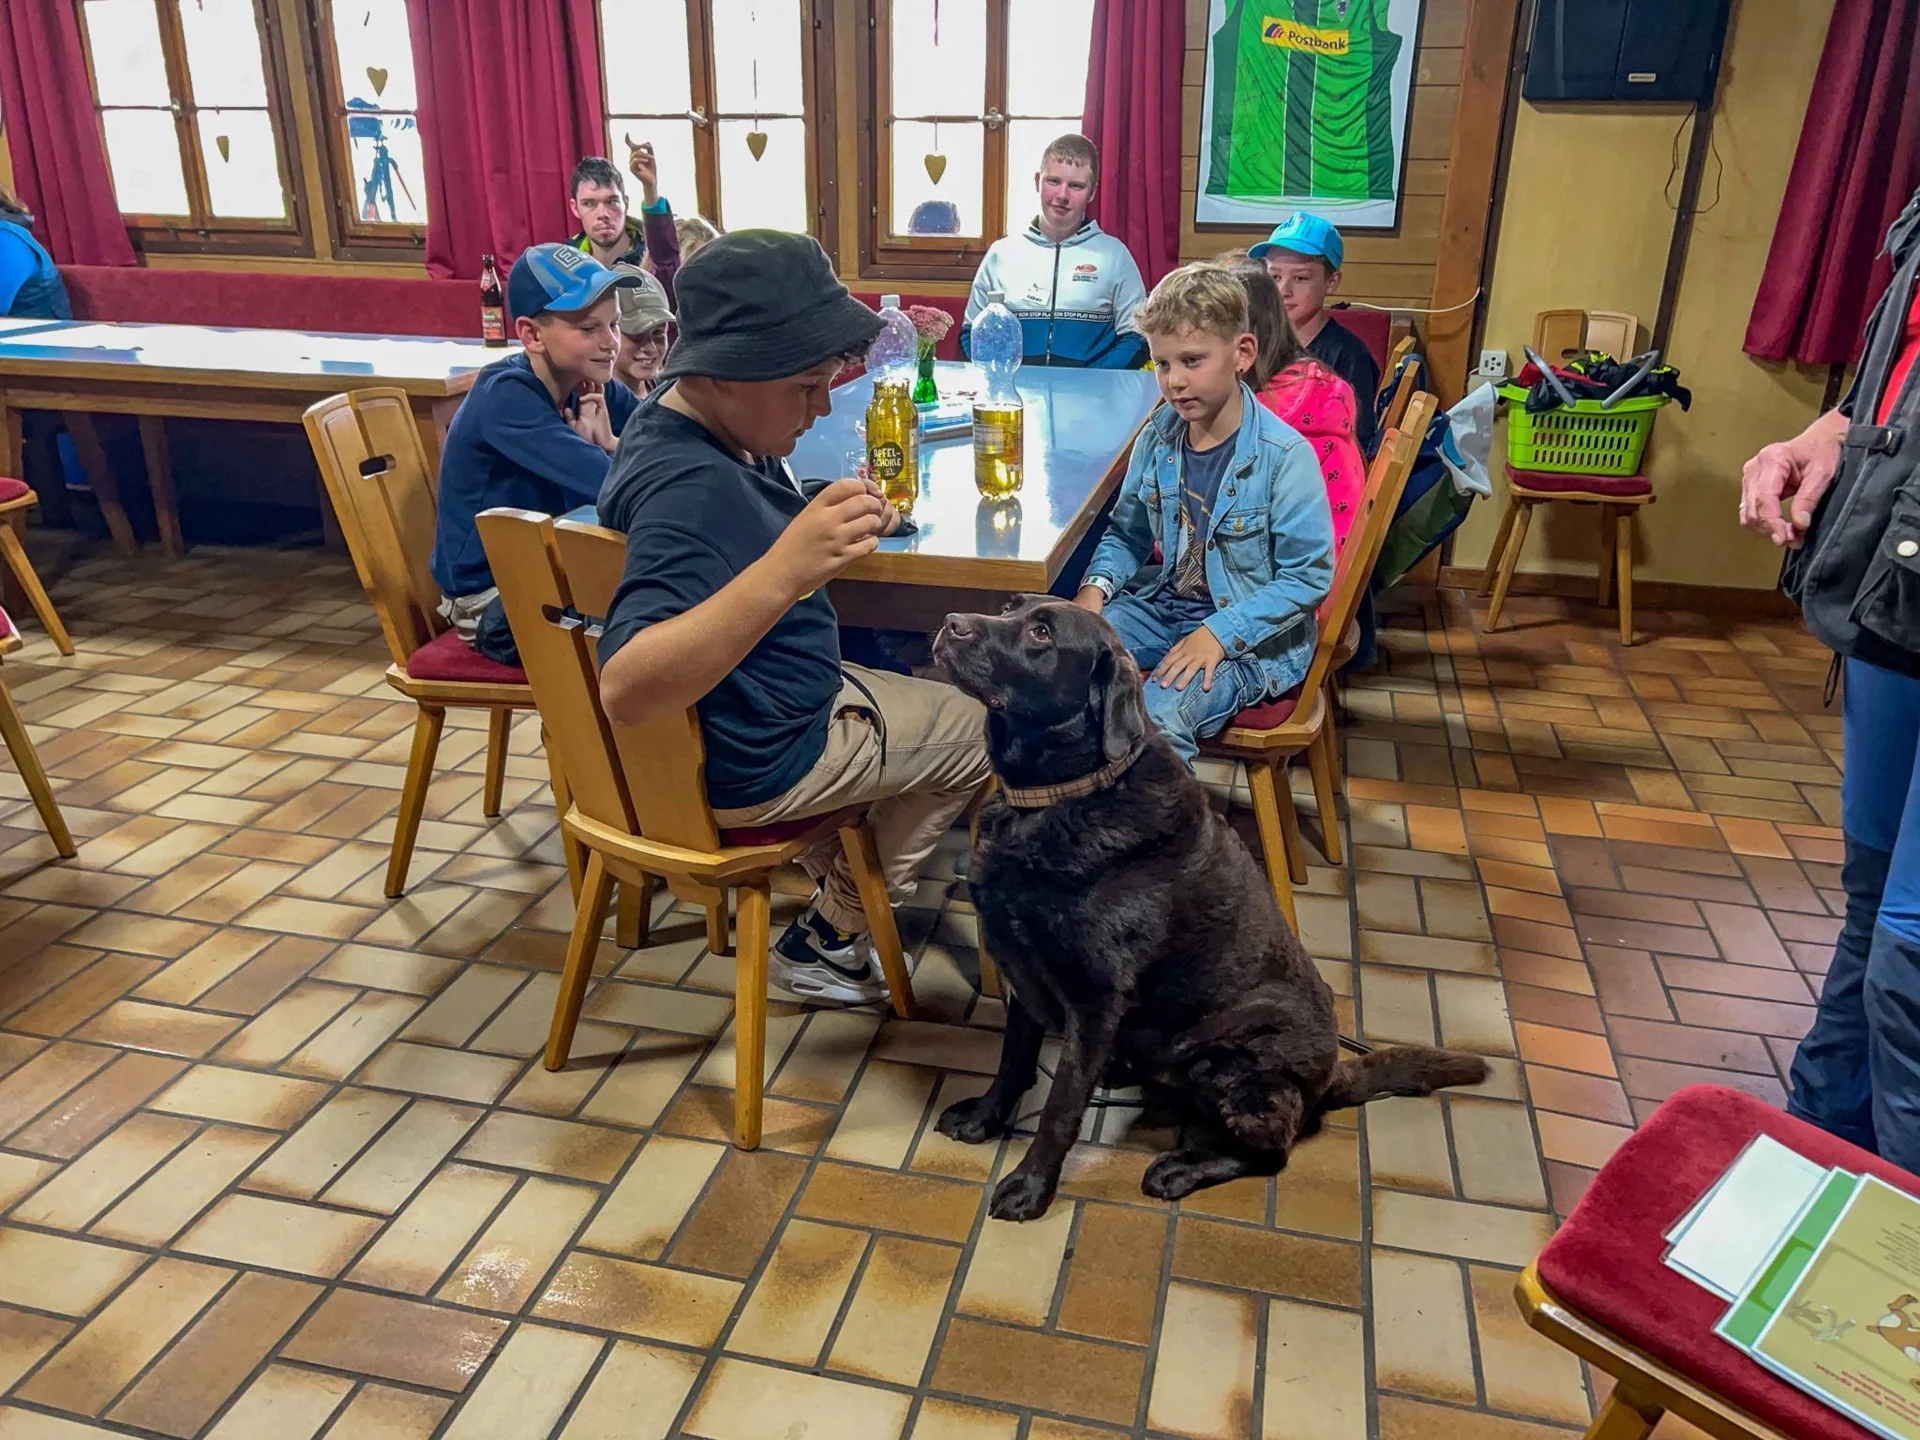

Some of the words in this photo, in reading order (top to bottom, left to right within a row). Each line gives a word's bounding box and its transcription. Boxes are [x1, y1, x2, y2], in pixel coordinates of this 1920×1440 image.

[1288, 29, 1347, 50] Postbank
[873, 447, 901, 459] APFEL-
[872, 457, 902, 468] SCHORLE
